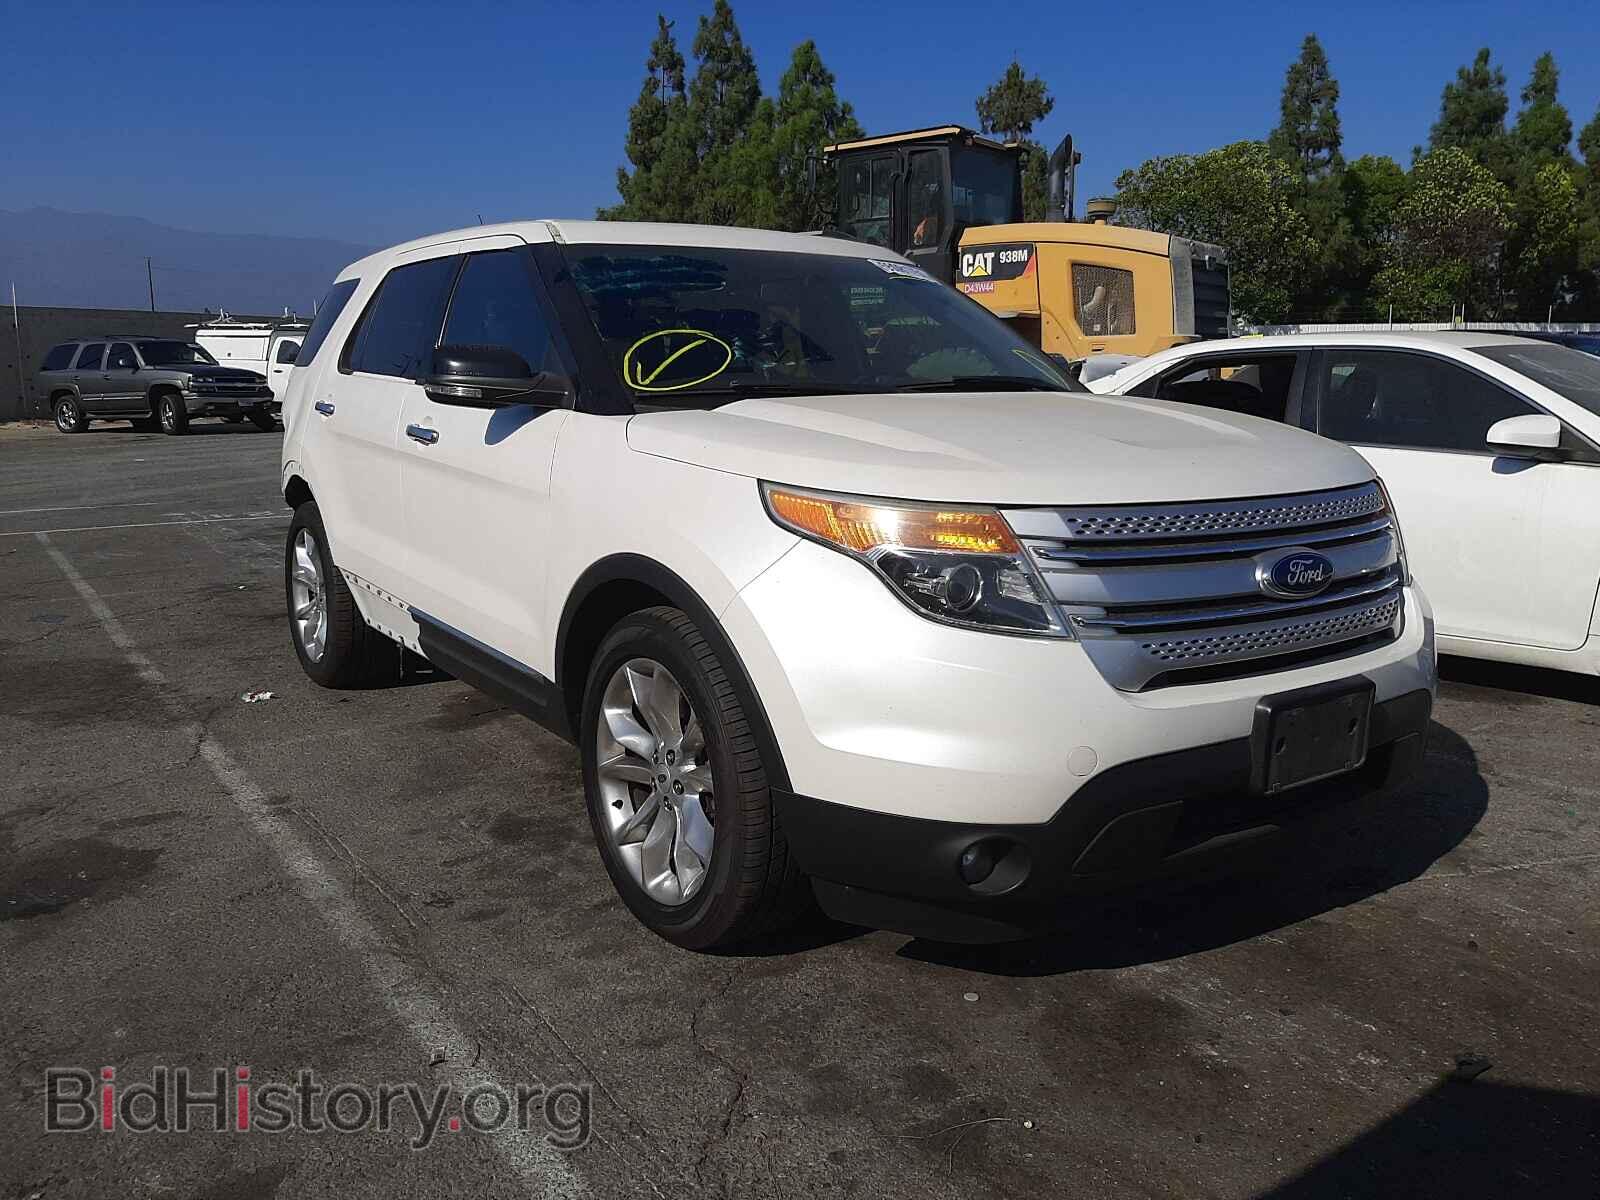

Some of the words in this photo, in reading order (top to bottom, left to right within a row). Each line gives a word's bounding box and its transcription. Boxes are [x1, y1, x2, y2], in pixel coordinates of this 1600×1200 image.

[963, 253, 994, 277] CAT
[1000, 249, 1028, 264] 938M
[1287, 560, 1324, 586] Ford
